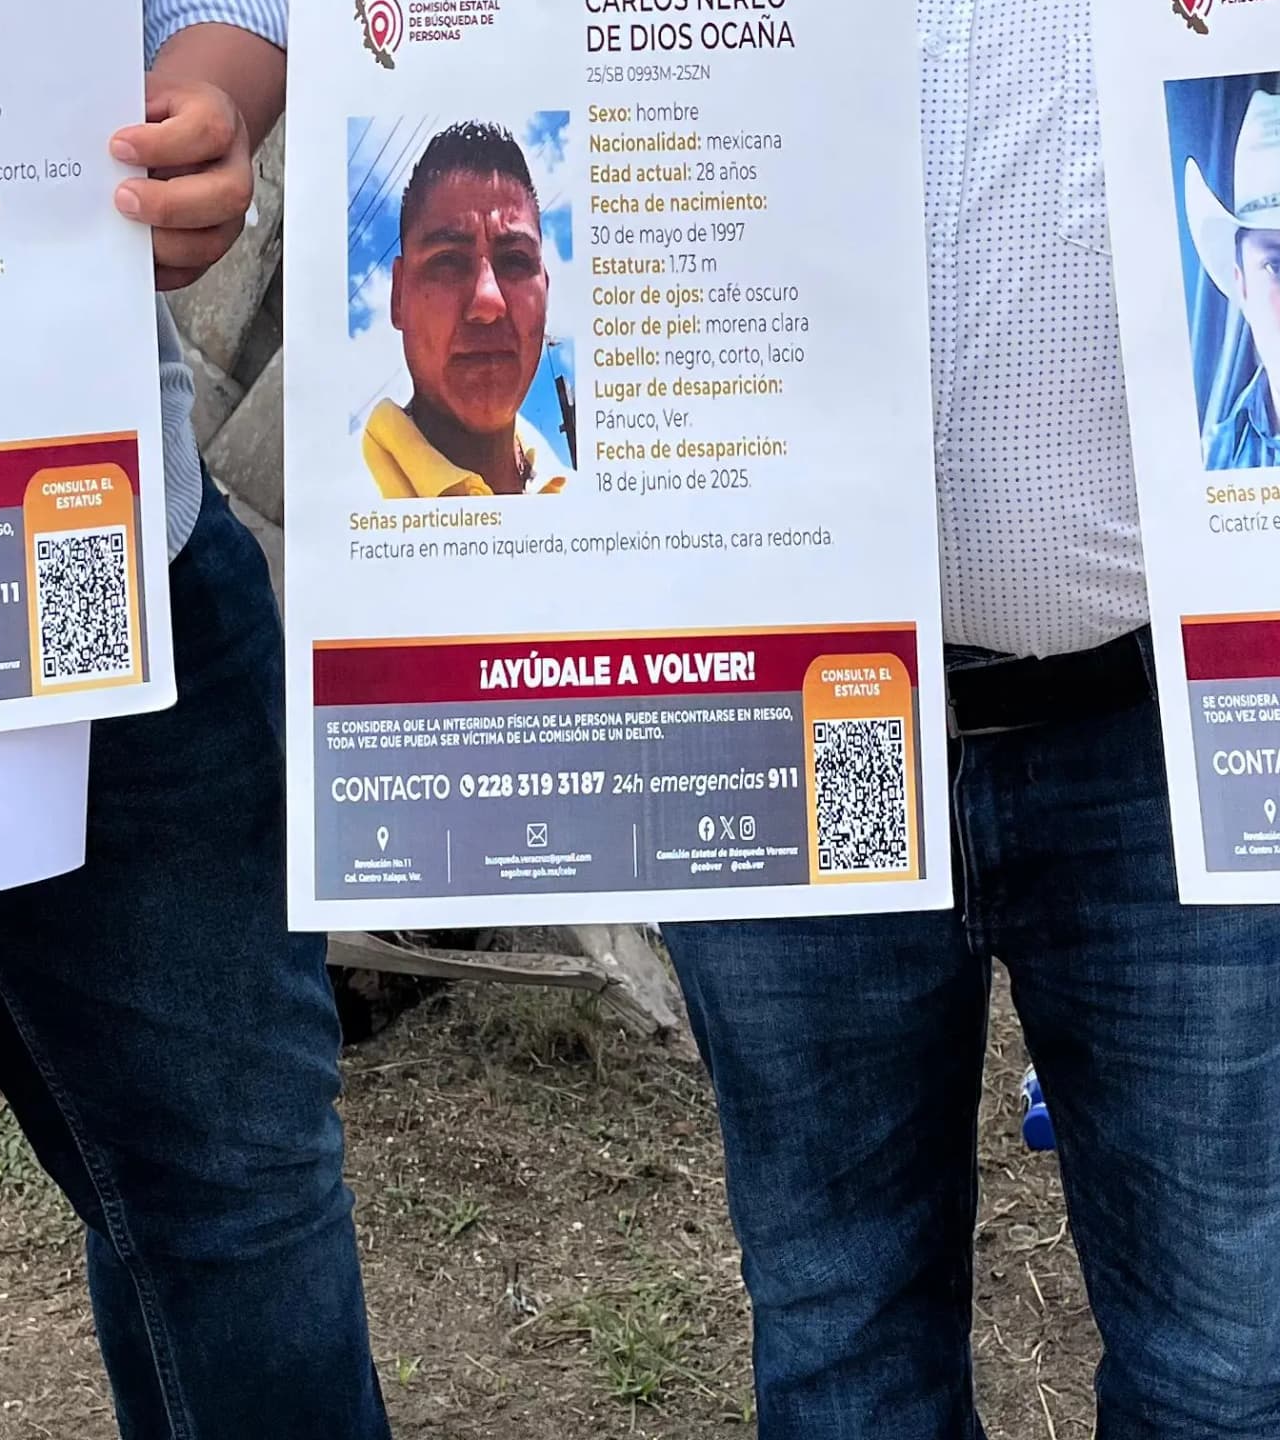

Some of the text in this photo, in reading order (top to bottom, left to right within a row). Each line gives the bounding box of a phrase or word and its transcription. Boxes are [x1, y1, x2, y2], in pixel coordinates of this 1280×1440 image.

[409, 0, 500, 13] COMISIÓN ESTATAL
[409, 14, 494, 28] DE BÚSQUEDA DE
[409, 29, 460, 41] PERSONAS
[587, 14, 795, 52] DE DIOS OCAÑA
[586, 64, 710, 84] 25/SB 0993M-25ZN
[588, 101, 699, 122] Sexo: hombre
[590, 130, 781, 152] Nacionalidad: mexicana
[41, 477, 114, 495] CONSULTA EL
[595, 468, 751, 495] 18 de junio de 2025.
[55, 493, 102, 510] ESTATUS
[1206, 484, 1256, 504] Señas
[479, 651, 755, 689] ¡AYÚDALE A VOLVER!
[820, 667, 892, 682] CONSULTA EL
[834, 683, 880, 698] ESTATUS
[326, 707, 793, 734] SE CONSIDERA QUE LA INTEGRIDAD FÍSICA DE LA PERSONA PUEDE ENCONTRARSE EN RIESGO,
[331, 767, 797, 802] CONTACTO 228 319 3187 24h emergencias 911
